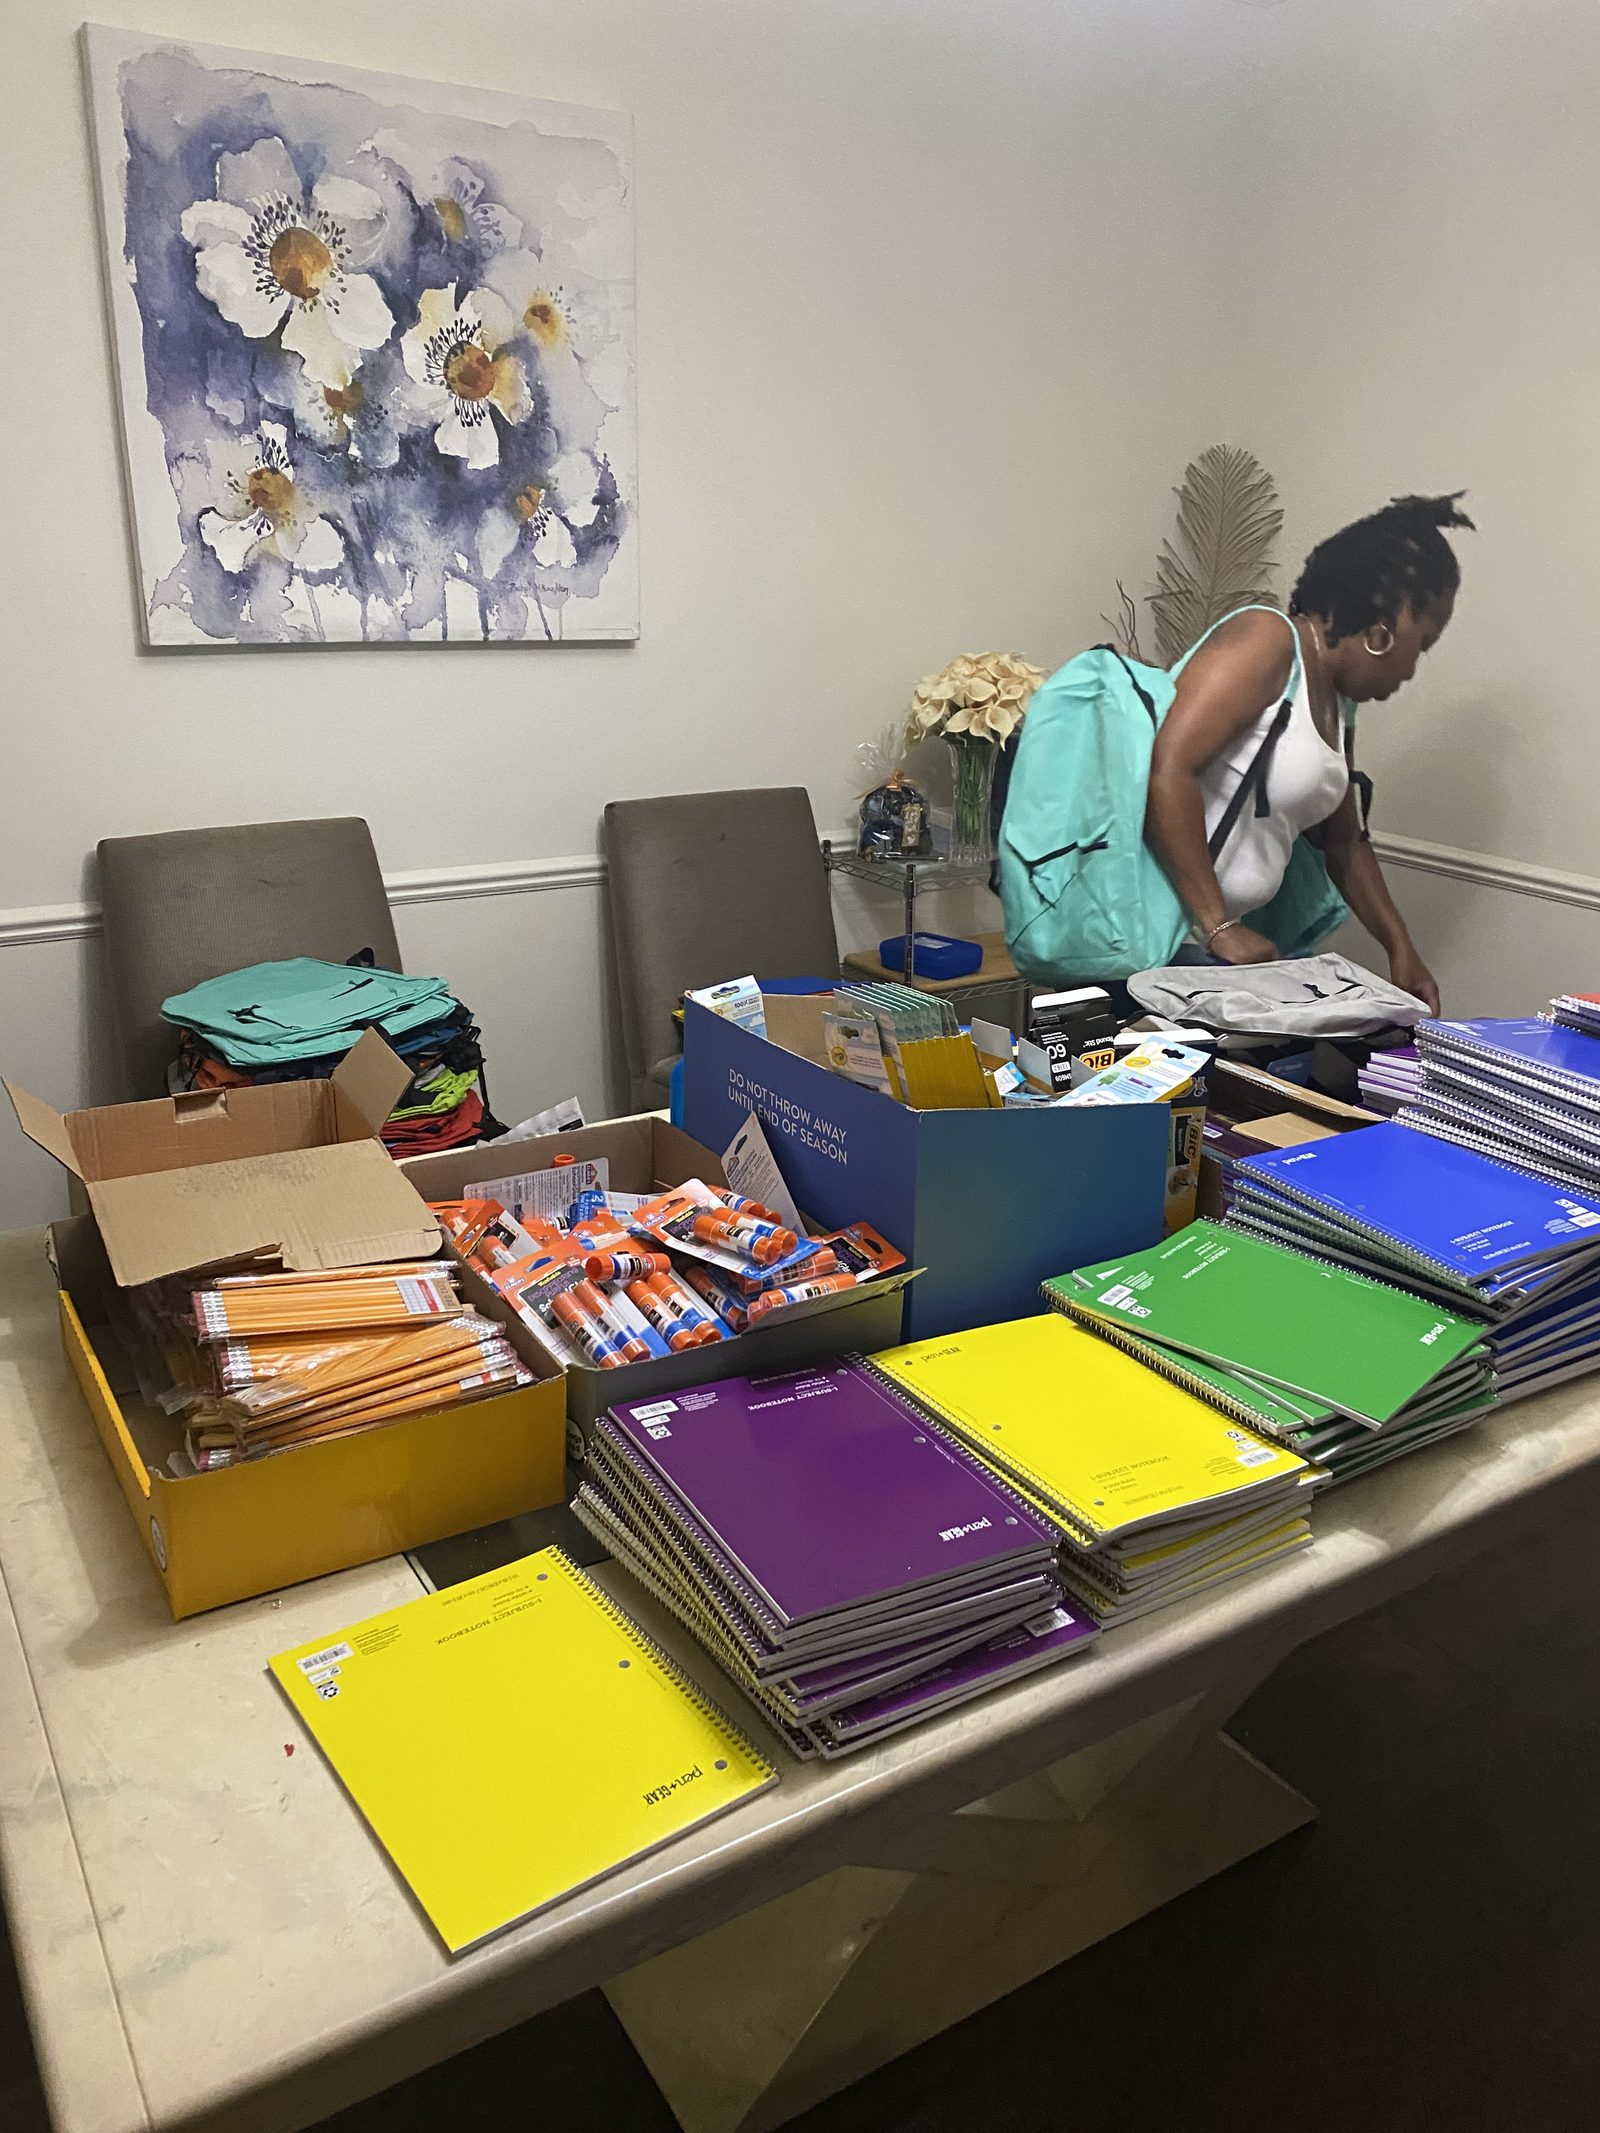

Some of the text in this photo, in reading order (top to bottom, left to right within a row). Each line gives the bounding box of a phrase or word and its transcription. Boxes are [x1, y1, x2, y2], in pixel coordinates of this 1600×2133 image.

[1046, 1043, 1066, 1060] 60
[728, 1085, 847, 1165] UNTIL END OF SEASON
[729, 1068, 847, 1144] DO NOT THROW AWAY
[643, 1765, 703, 1805] pen+GEAR
